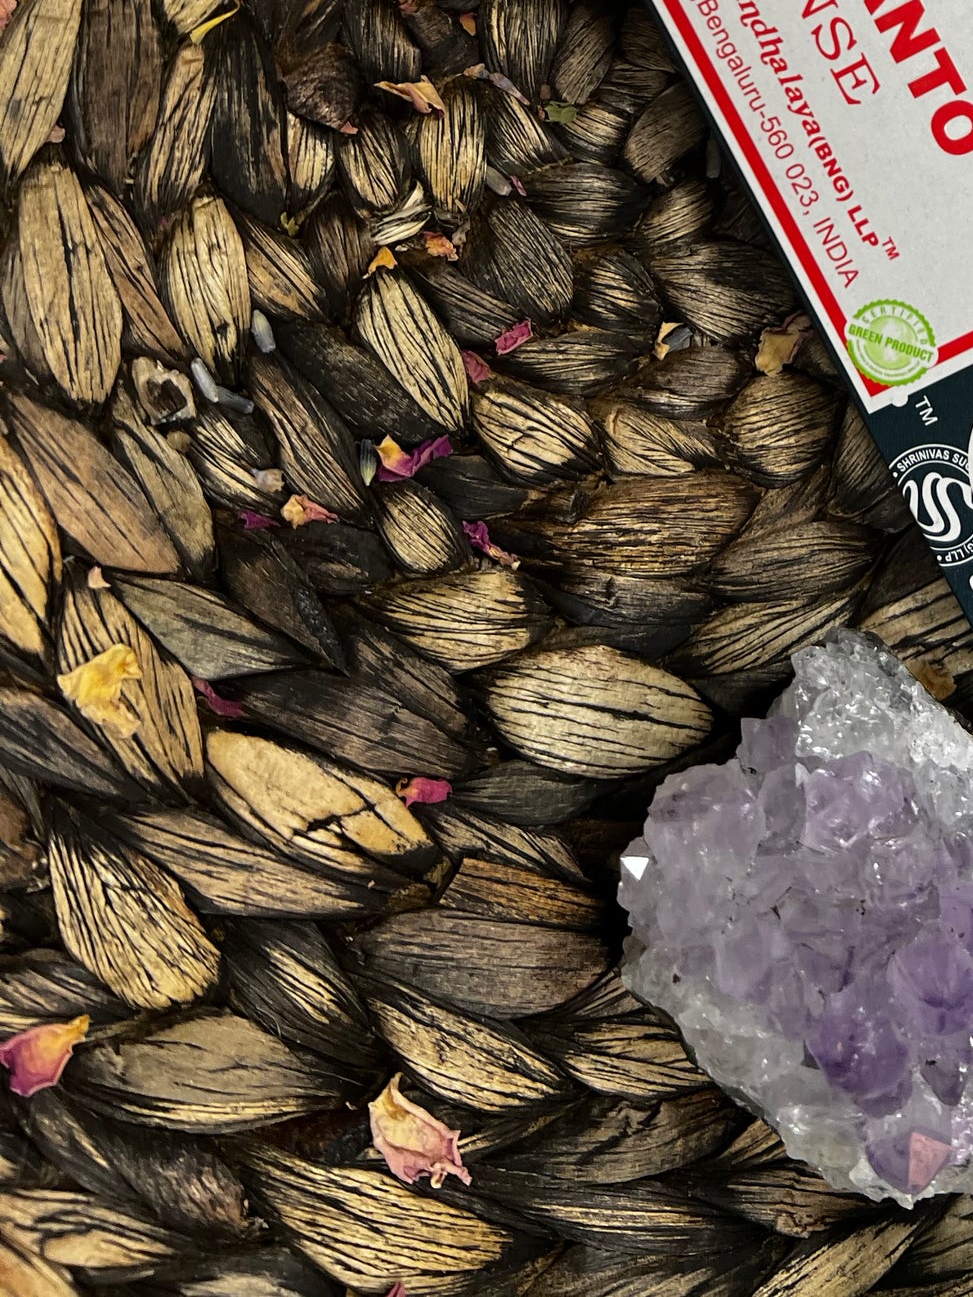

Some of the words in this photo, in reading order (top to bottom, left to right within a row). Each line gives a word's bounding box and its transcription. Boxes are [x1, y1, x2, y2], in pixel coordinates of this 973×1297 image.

[786, 163, 819, 215] 023,
[814, 217, 859, 288] INDIA
[848, 324, 883, 345] GREEN
[884, 336, 934, 363] PRODUCT
[862, 306, 928, 345] CERTIFIED
[896, 449, 949, 472] SHRINIVAS
